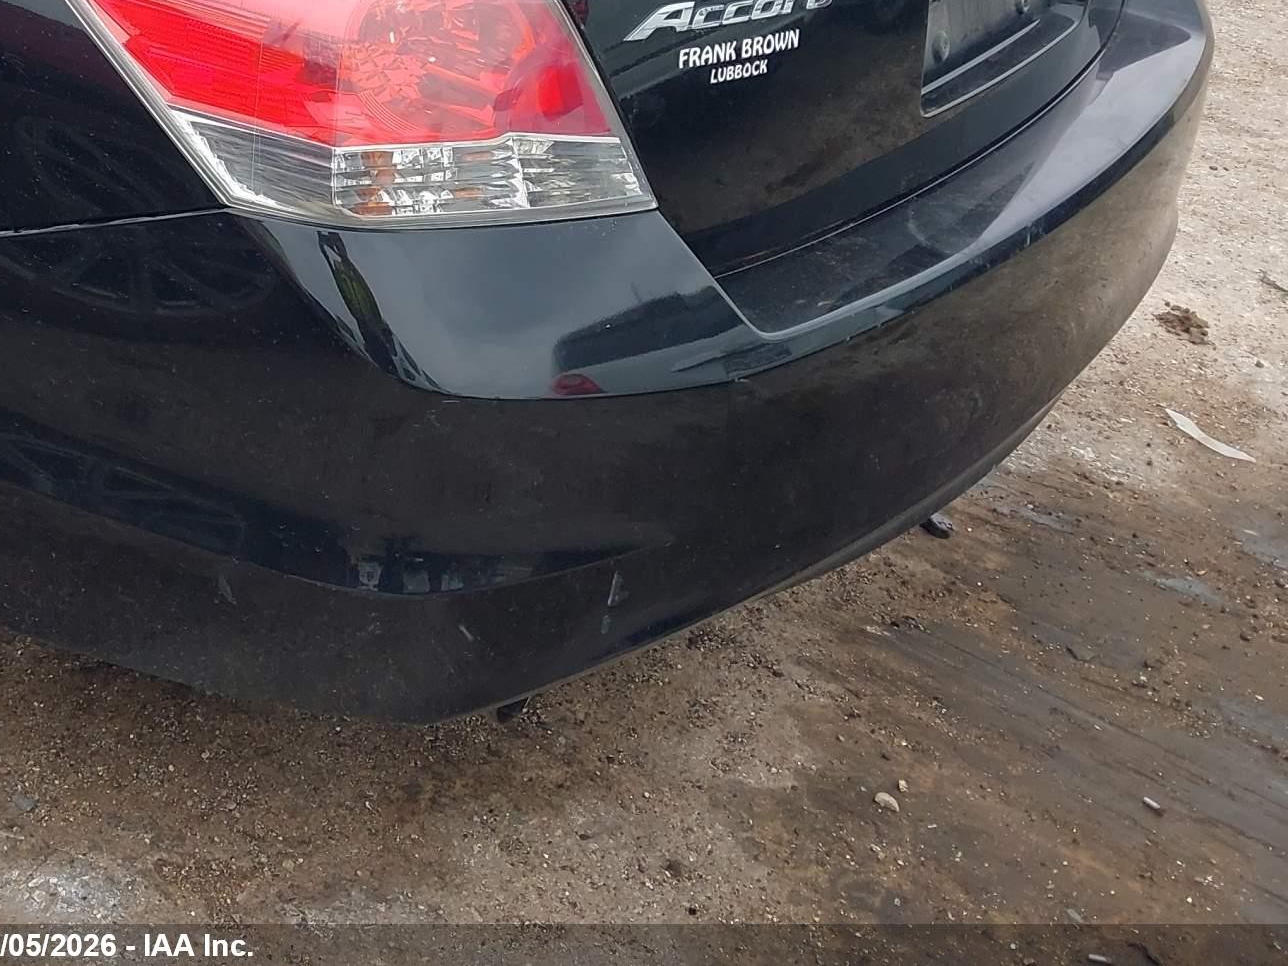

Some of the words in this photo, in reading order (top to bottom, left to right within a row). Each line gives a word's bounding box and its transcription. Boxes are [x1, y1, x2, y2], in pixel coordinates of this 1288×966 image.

[678, 42, 737, 70] FRANK
[741, 29, 801, 59] BROWN
[710, 59, 769, 84] LUBBOCK
